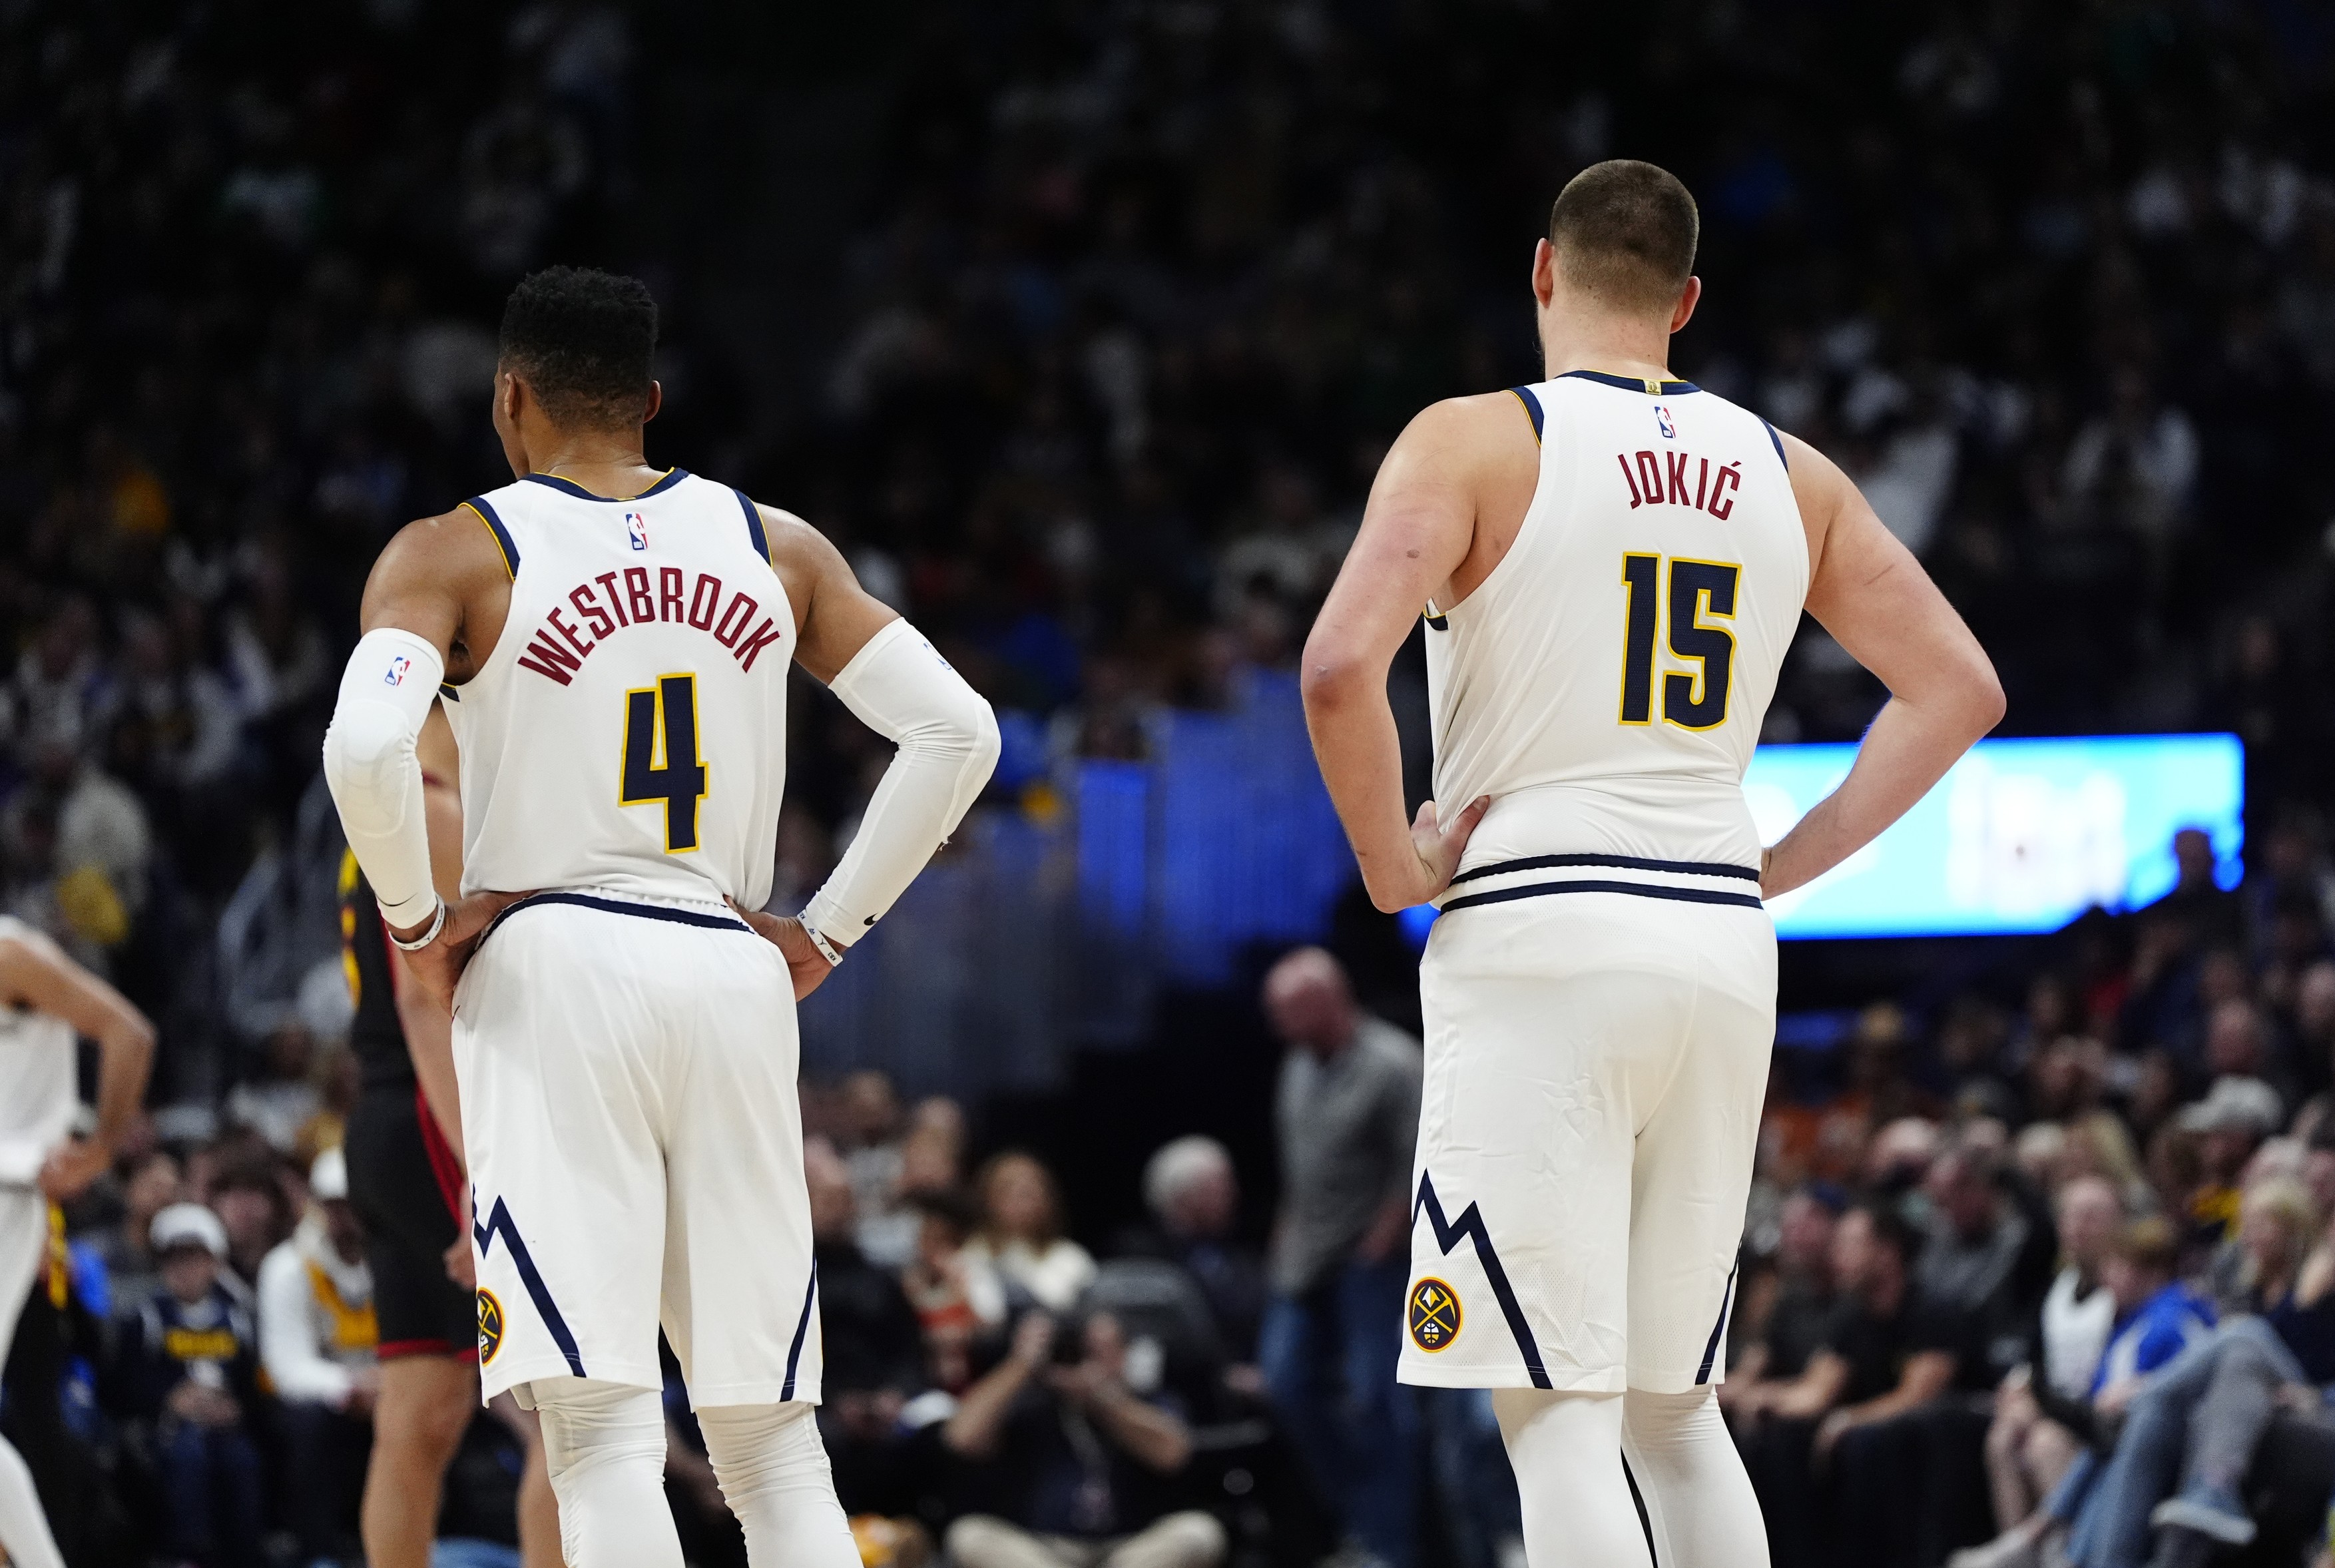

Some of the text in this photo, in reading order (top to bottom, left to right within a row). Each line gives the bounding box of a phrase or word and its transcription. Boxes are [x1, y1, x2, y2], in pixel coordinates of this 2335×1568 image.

[1618, 451, 1741, 521] JOKIĆ
[517, 567, 780, 686] WESTBROOK
[1618, 551, 1743, 732] 15
[618, 671, 710, 856] 4
